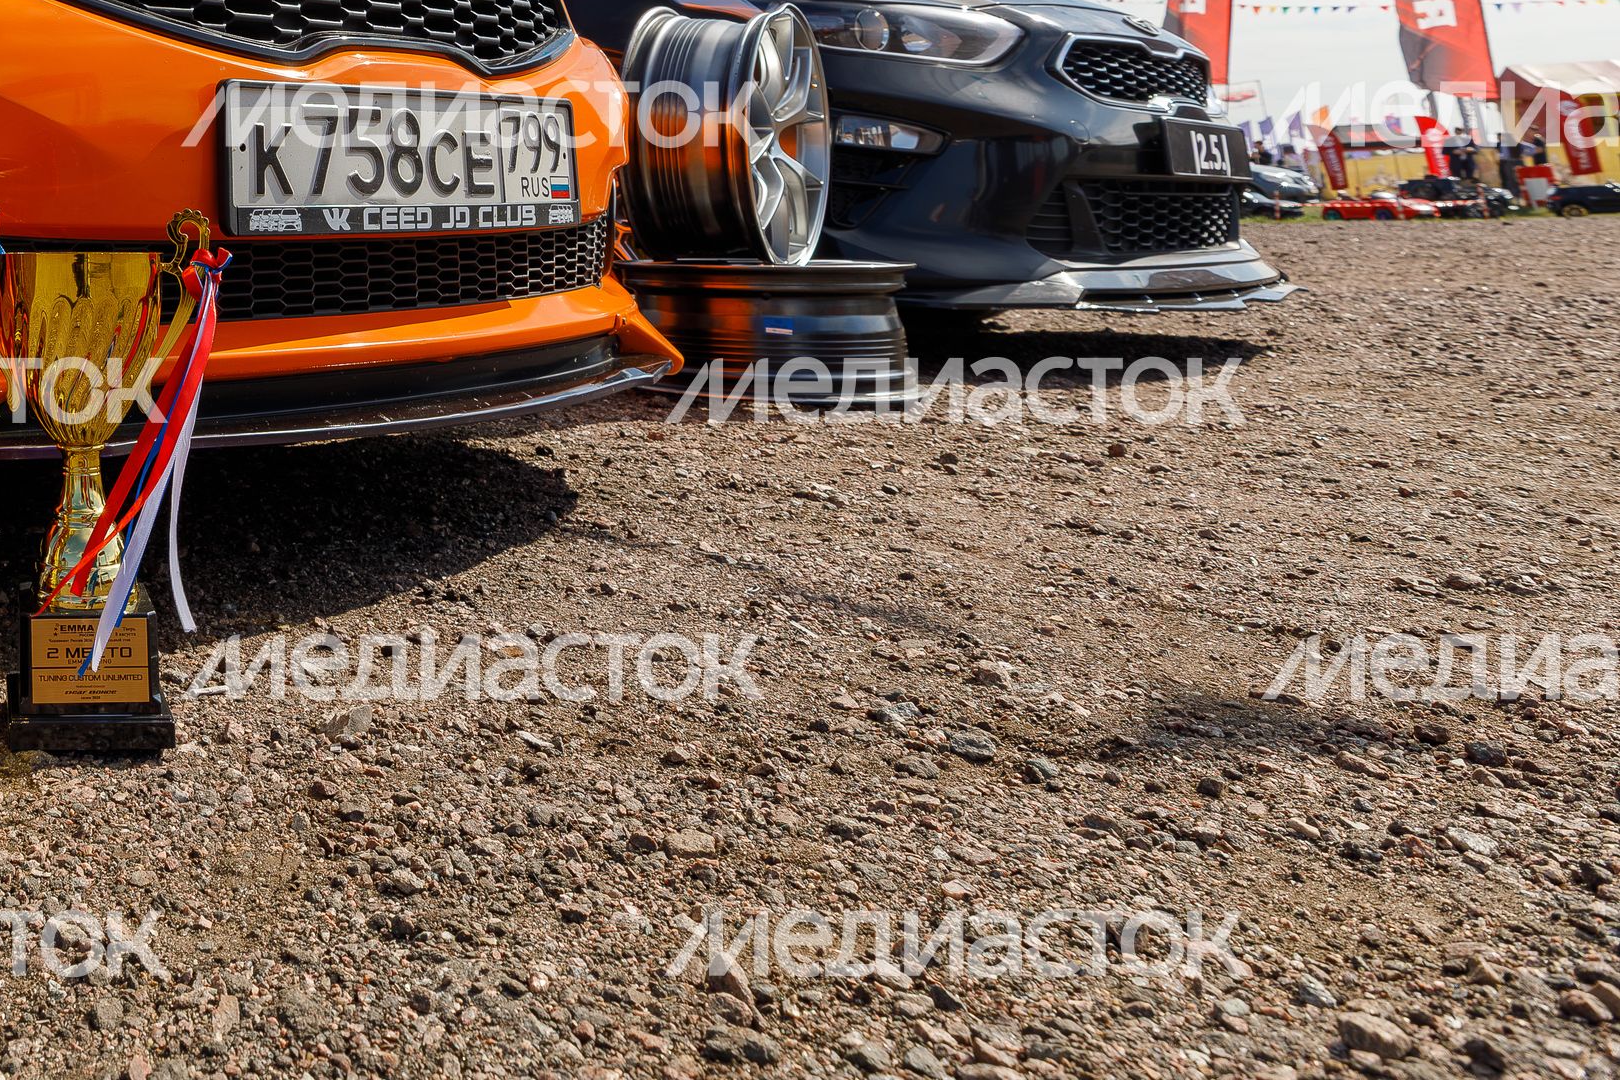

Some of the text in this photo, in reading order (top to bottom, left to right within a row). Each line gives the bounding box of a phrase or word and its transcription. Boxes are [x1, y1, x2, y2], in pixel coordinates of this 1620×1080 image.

[520, 176, 550, 198] RUS
[363, 207, 433, 230] CEED
[478, 205, 537, 228] CLUB
[60, 624, 95, 632] EMMA
[46, 646, 132, 659] 2 МЕТО
